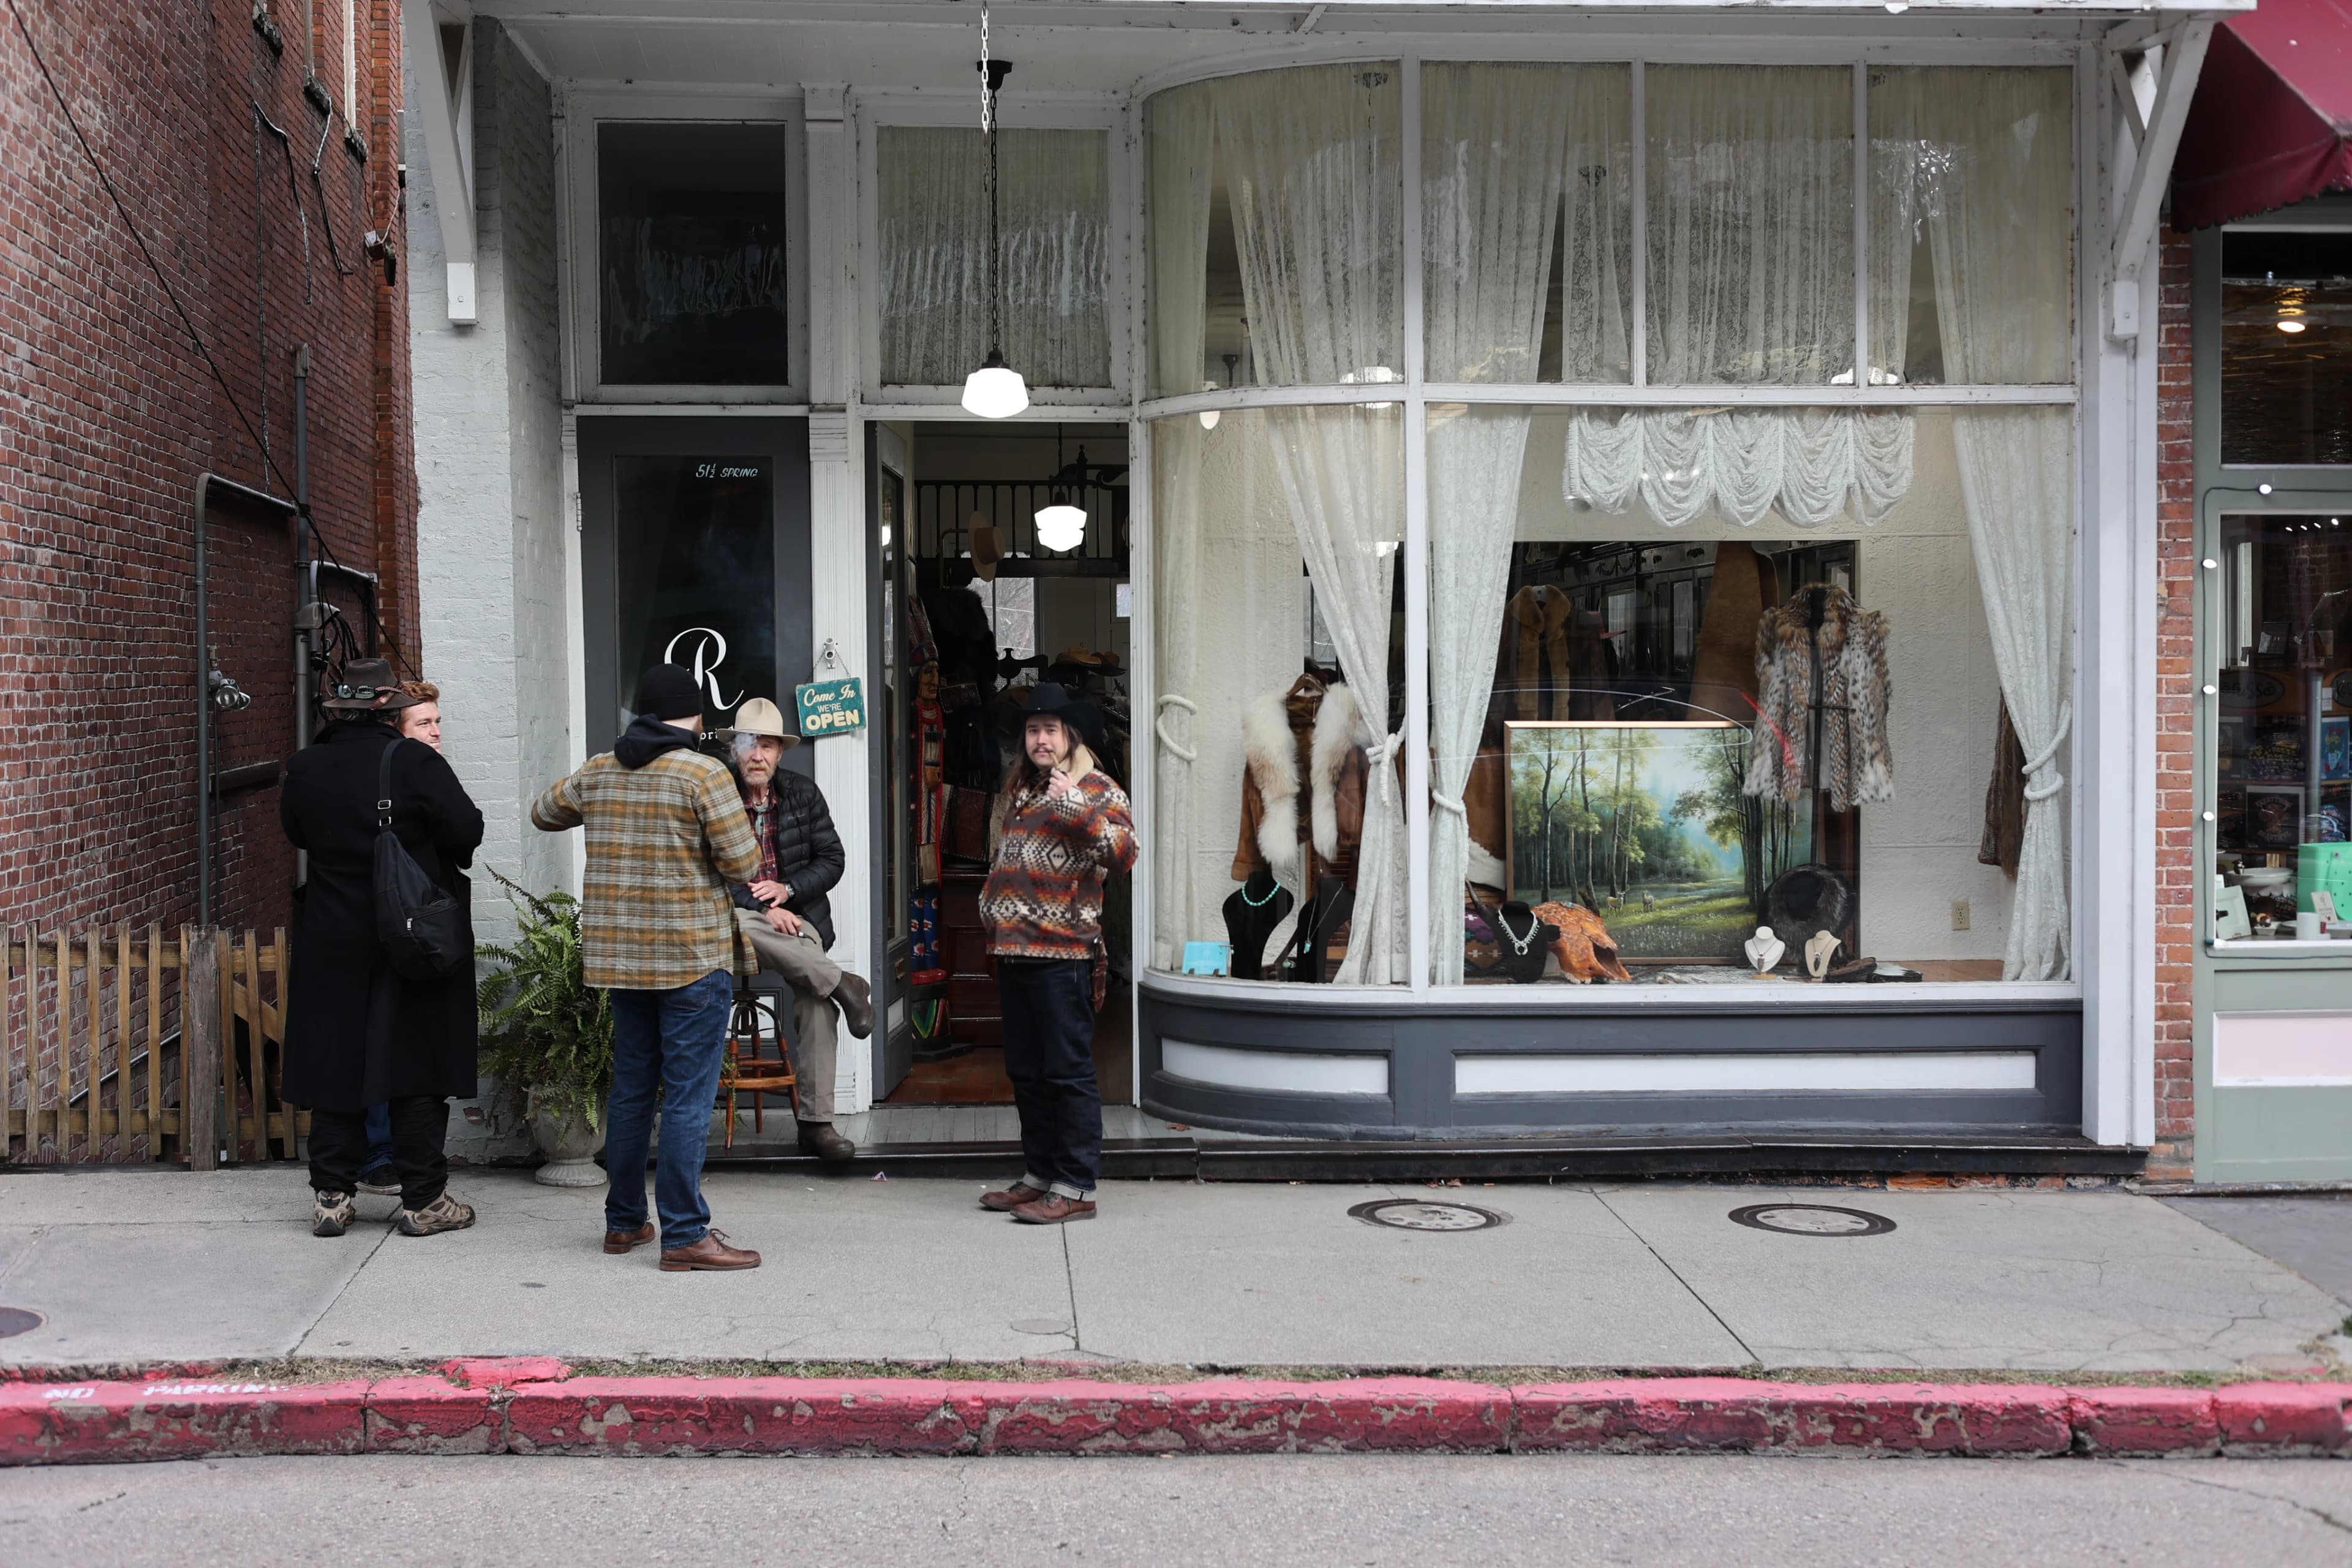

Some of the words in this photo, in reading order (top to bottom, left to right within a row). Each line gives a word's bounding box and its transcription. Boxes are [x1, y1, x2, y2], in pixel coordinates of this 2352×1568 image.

[720, 467, 758, 478] SPRING
[664, 627, 744, 711] R
[804, 688, 835, 707] Come
[839, 684, 856, 700] In
[817, 703, 842, 713] WE'RE
[805, 709, 860, 731] OPEN
[41, 1387, 95, 1399] NO
